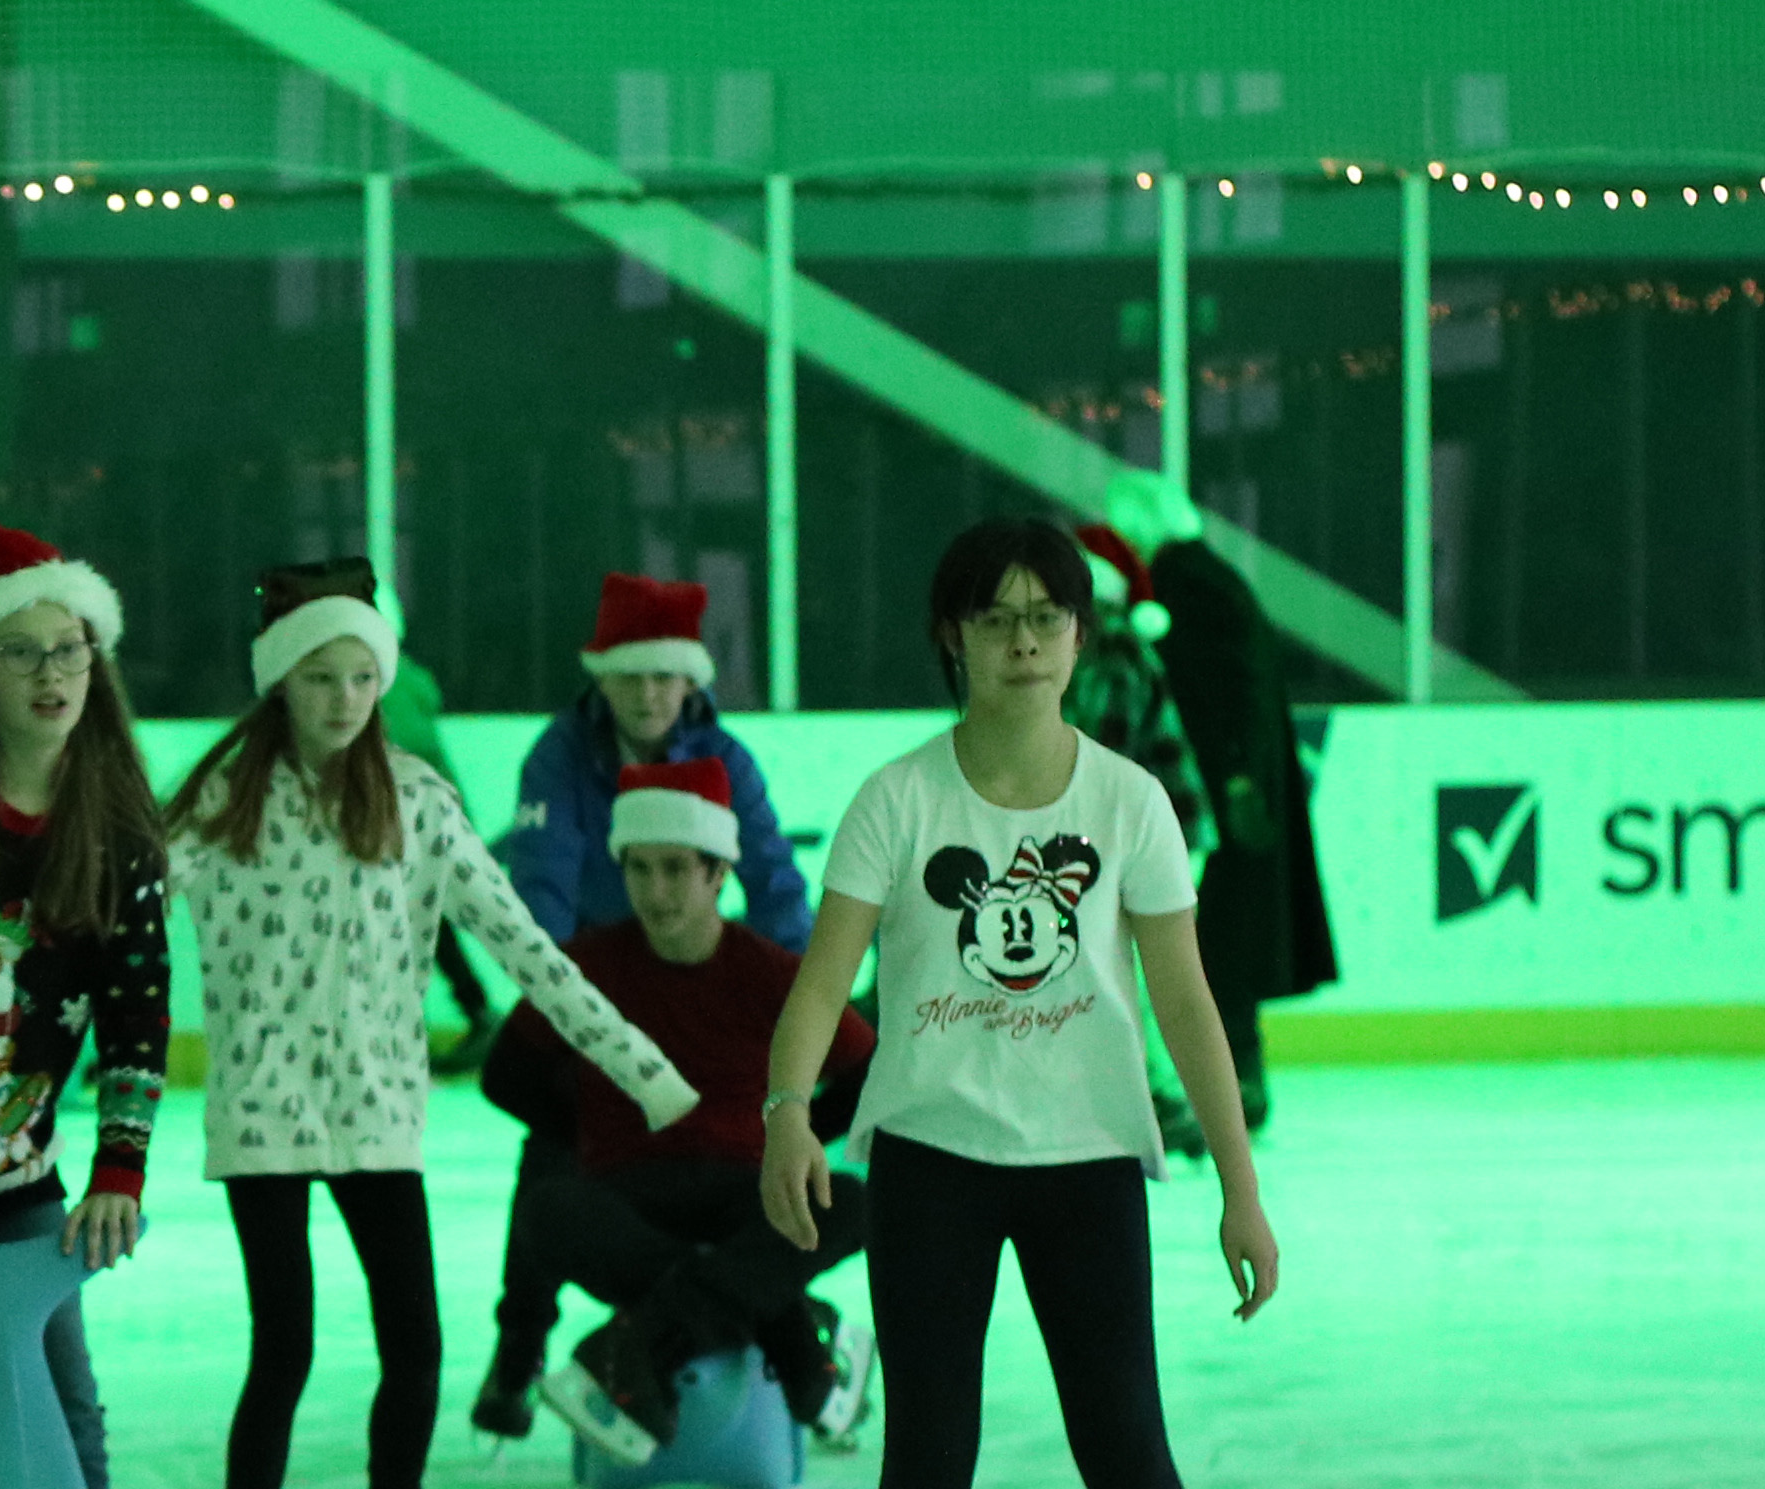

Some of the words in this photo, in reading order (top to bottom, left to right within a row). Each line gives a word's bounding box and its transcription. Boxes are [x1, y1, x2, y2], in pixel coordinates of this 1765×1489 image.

[1602, 802, 1765, 895] sm
[911, 992, 1007, 1036] Minnie
[1011, 994, 1097, 1040] Bright
